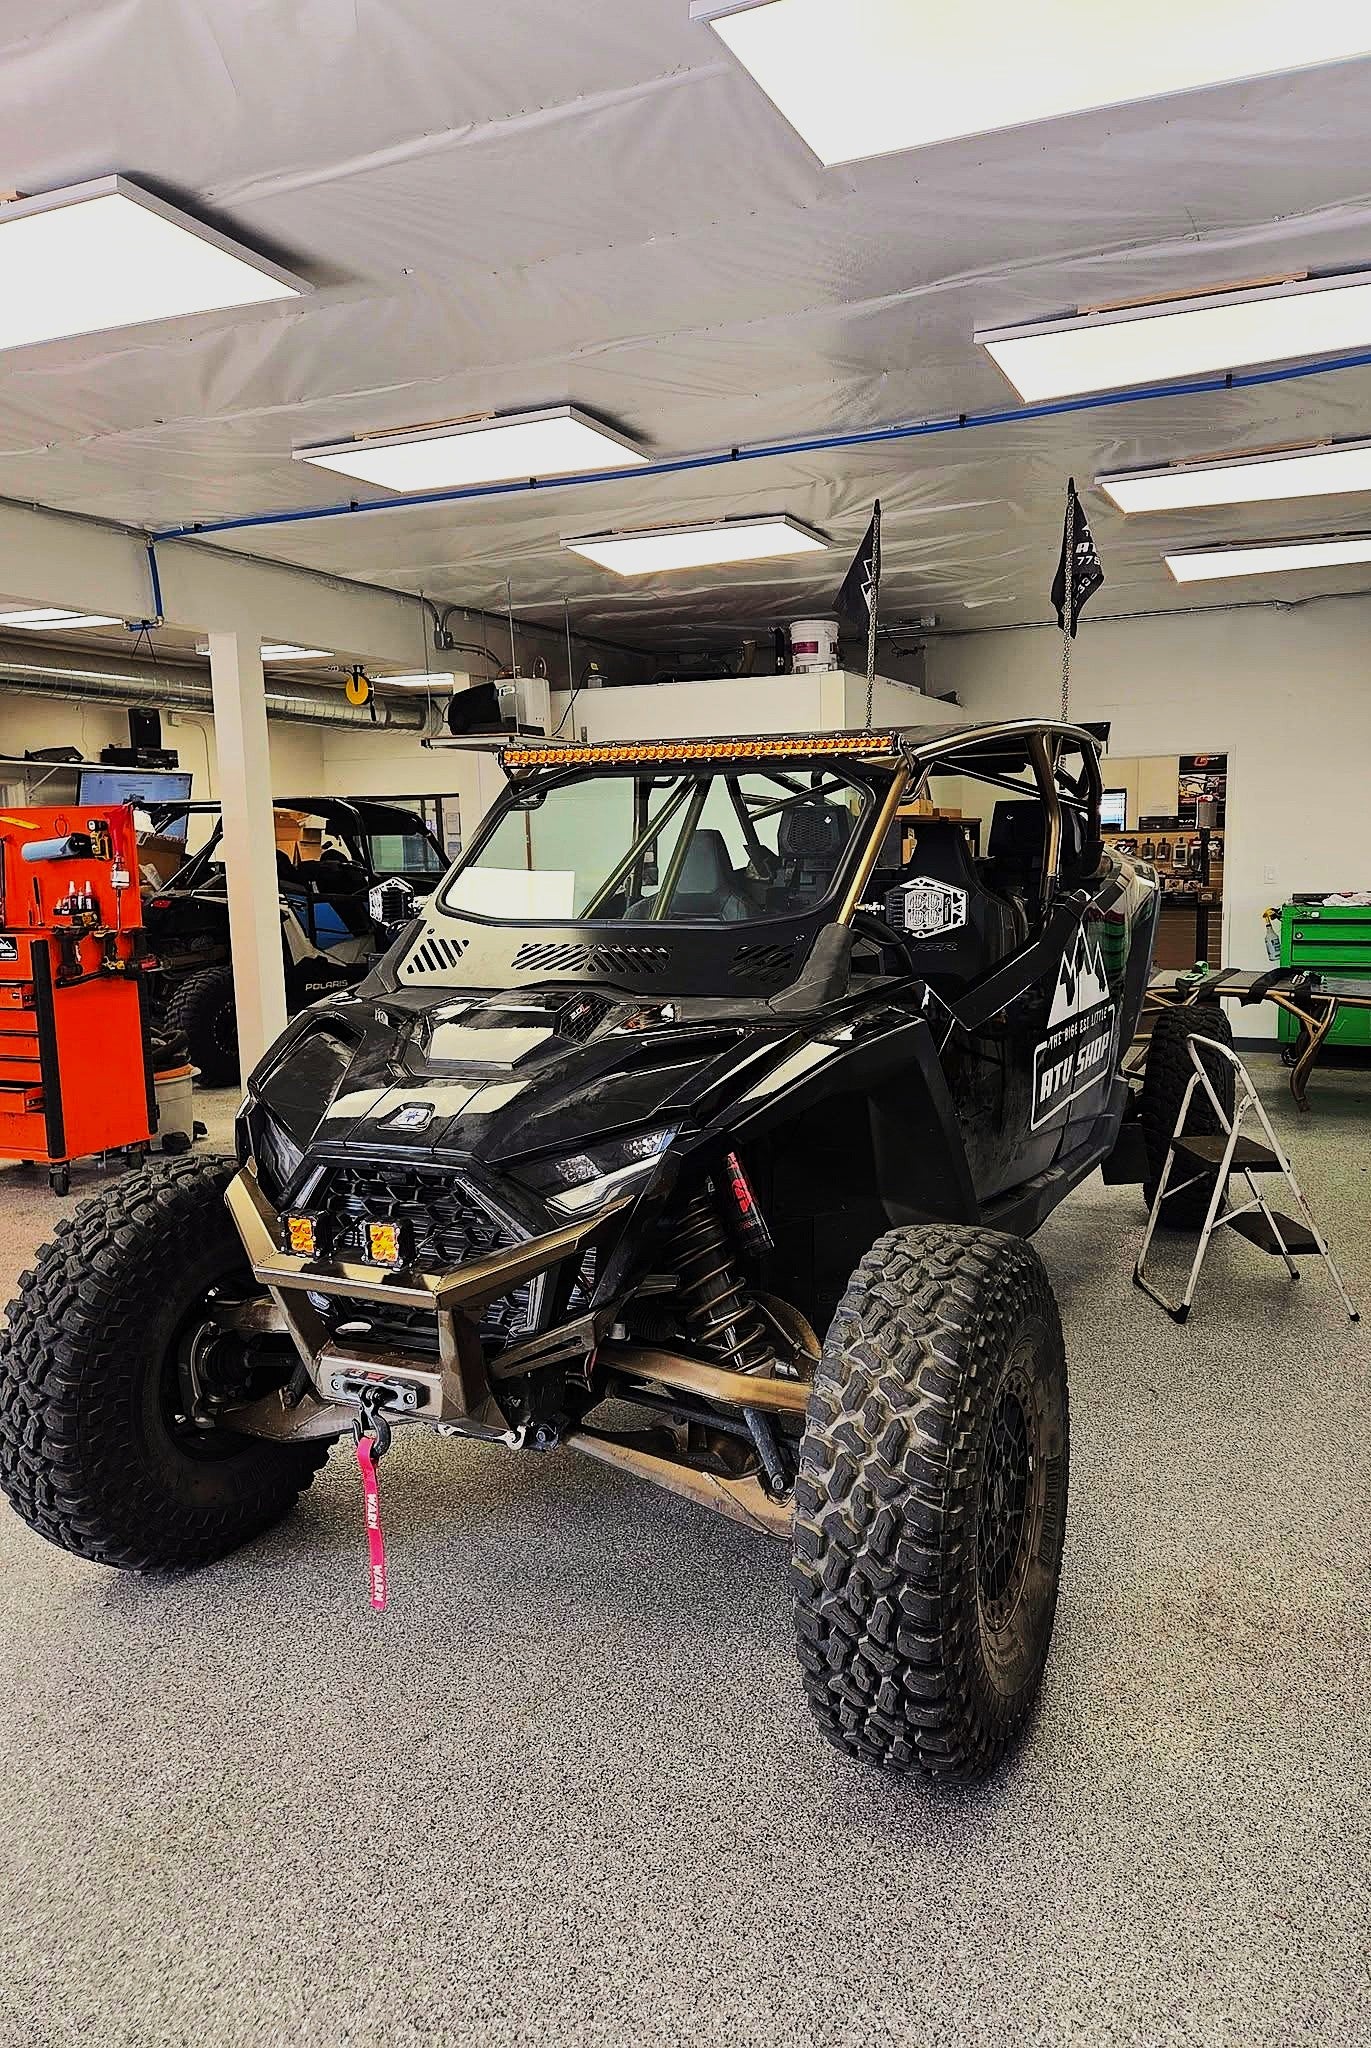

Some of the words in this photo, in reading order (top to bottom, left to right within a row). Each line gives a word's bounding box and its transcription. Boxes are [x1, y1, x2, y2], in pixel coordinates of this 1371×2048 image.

[305, 980, 348, 991] POLARIS
[1049, 1031, 1062, 1050] THE
[1091, 1006, 1108, 1027] LITTLE
[1040, 1054, 1074, 1103] ATV
[1074, 1031, 1110, 1077] SHOP
[366, 1493, 379, 1530] WARN
[372, 1564, 385, 1602] WARN
